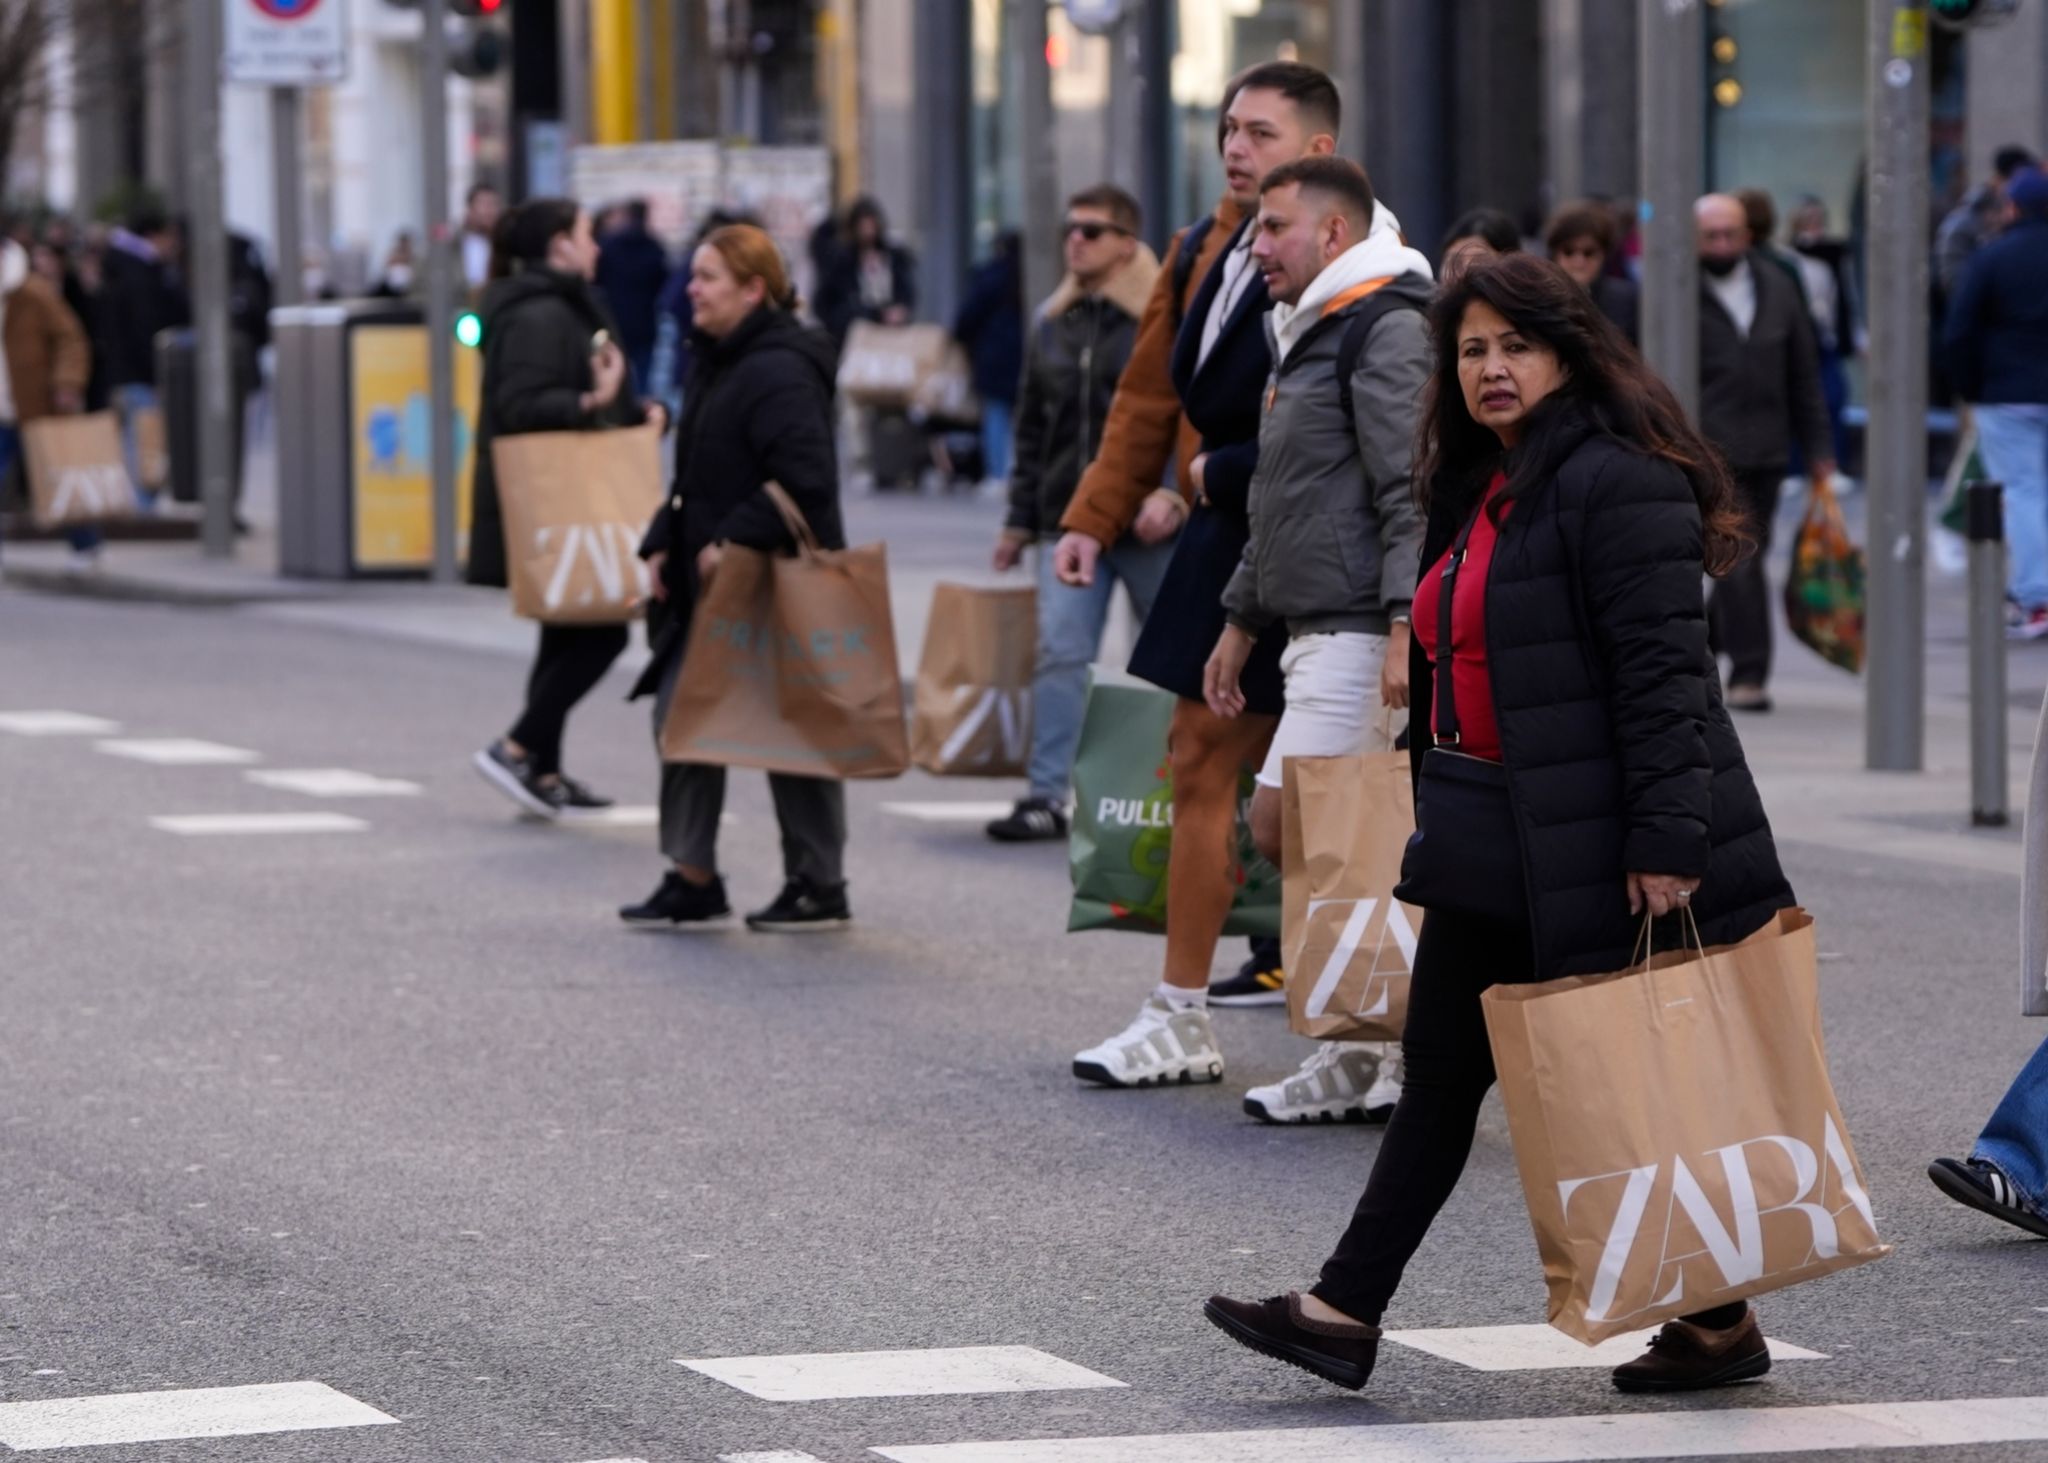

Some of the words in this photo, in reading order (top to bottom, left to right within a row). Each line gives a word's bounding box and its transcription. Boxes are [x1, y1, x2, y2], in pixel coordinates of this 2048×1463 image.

[535, 518, 654, 609] ZAR
[1304, 896, 1418, 1019] ZA
[1557, 1110, 1884, 1322] ZARA
